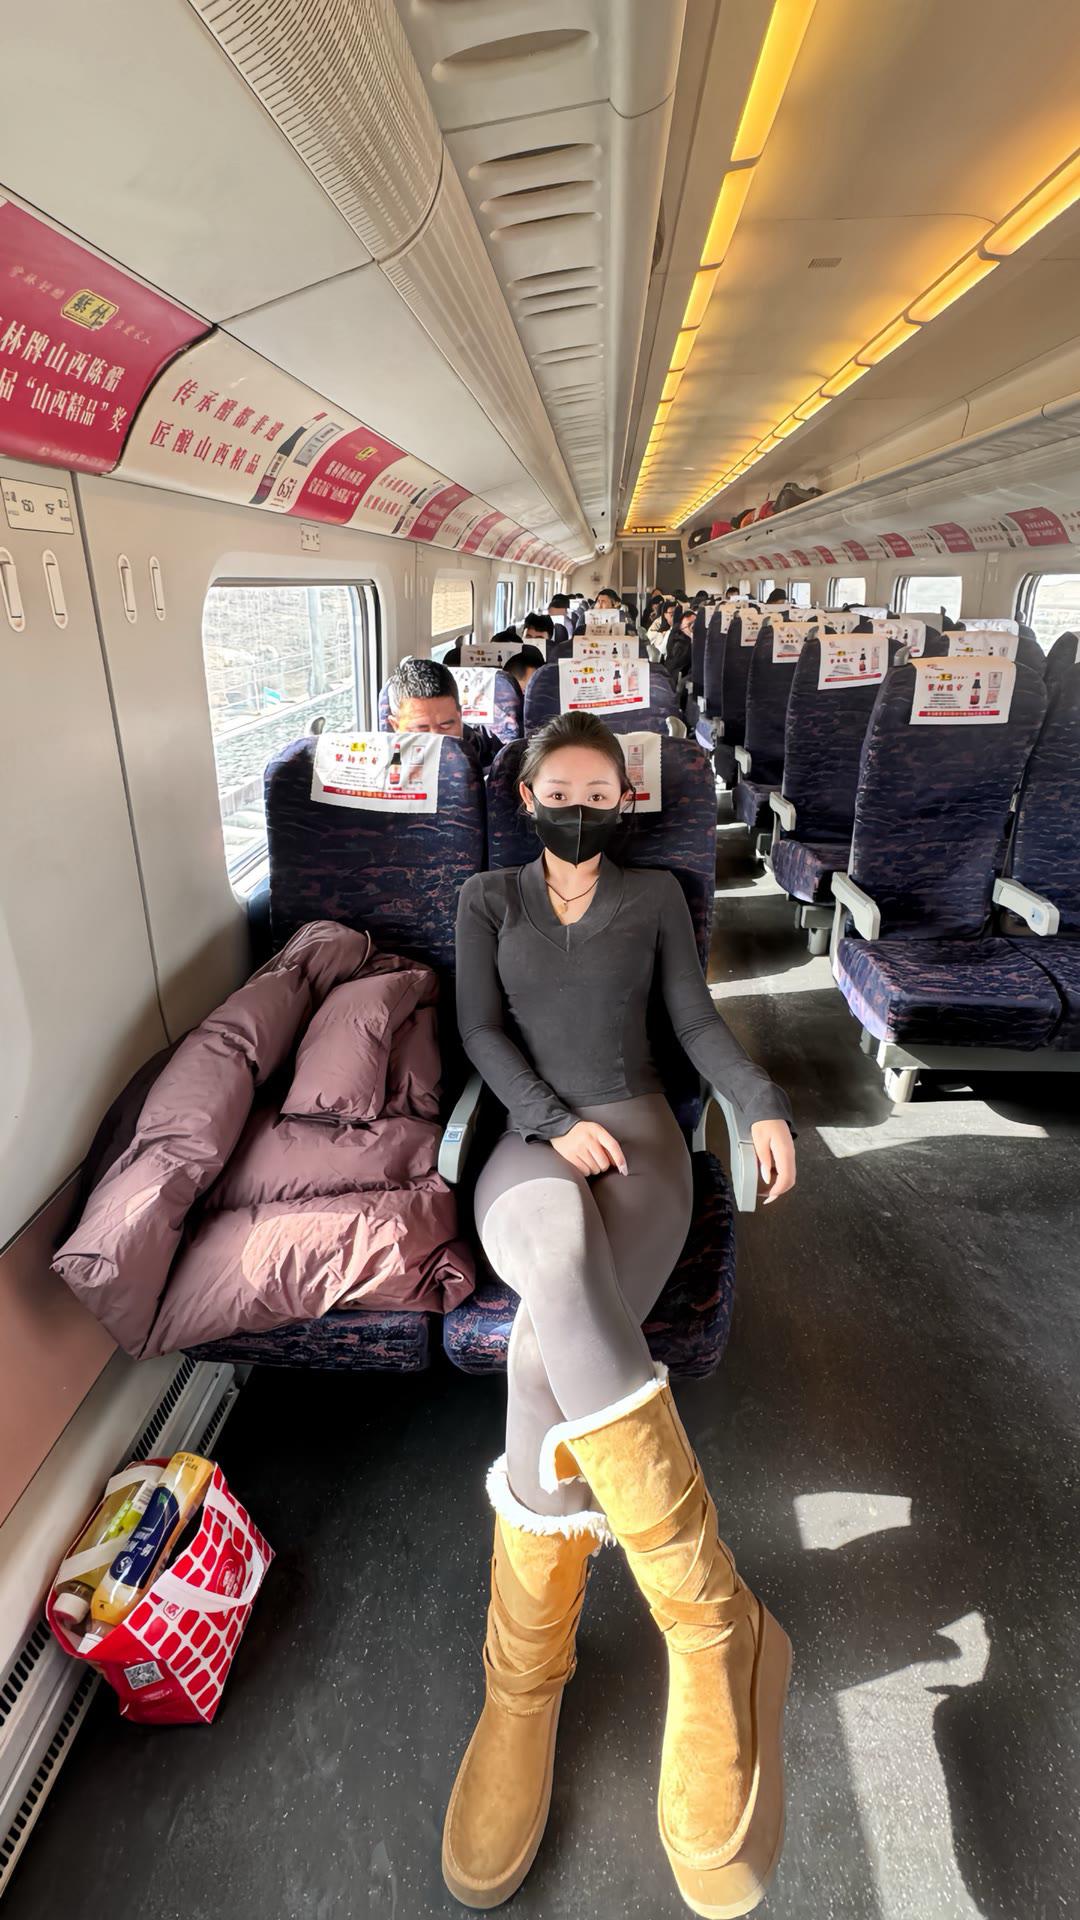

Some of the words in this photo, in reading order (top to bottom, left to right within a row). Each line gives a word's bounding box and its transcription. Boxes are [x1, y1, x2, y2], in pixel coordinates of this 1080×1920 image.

[0, 317, 125, 392] 林牌山西陈醋
[171, 379, 286, 442] 传承醋都非遗
[149, 420, 263, 475] 匠酿山西精品
